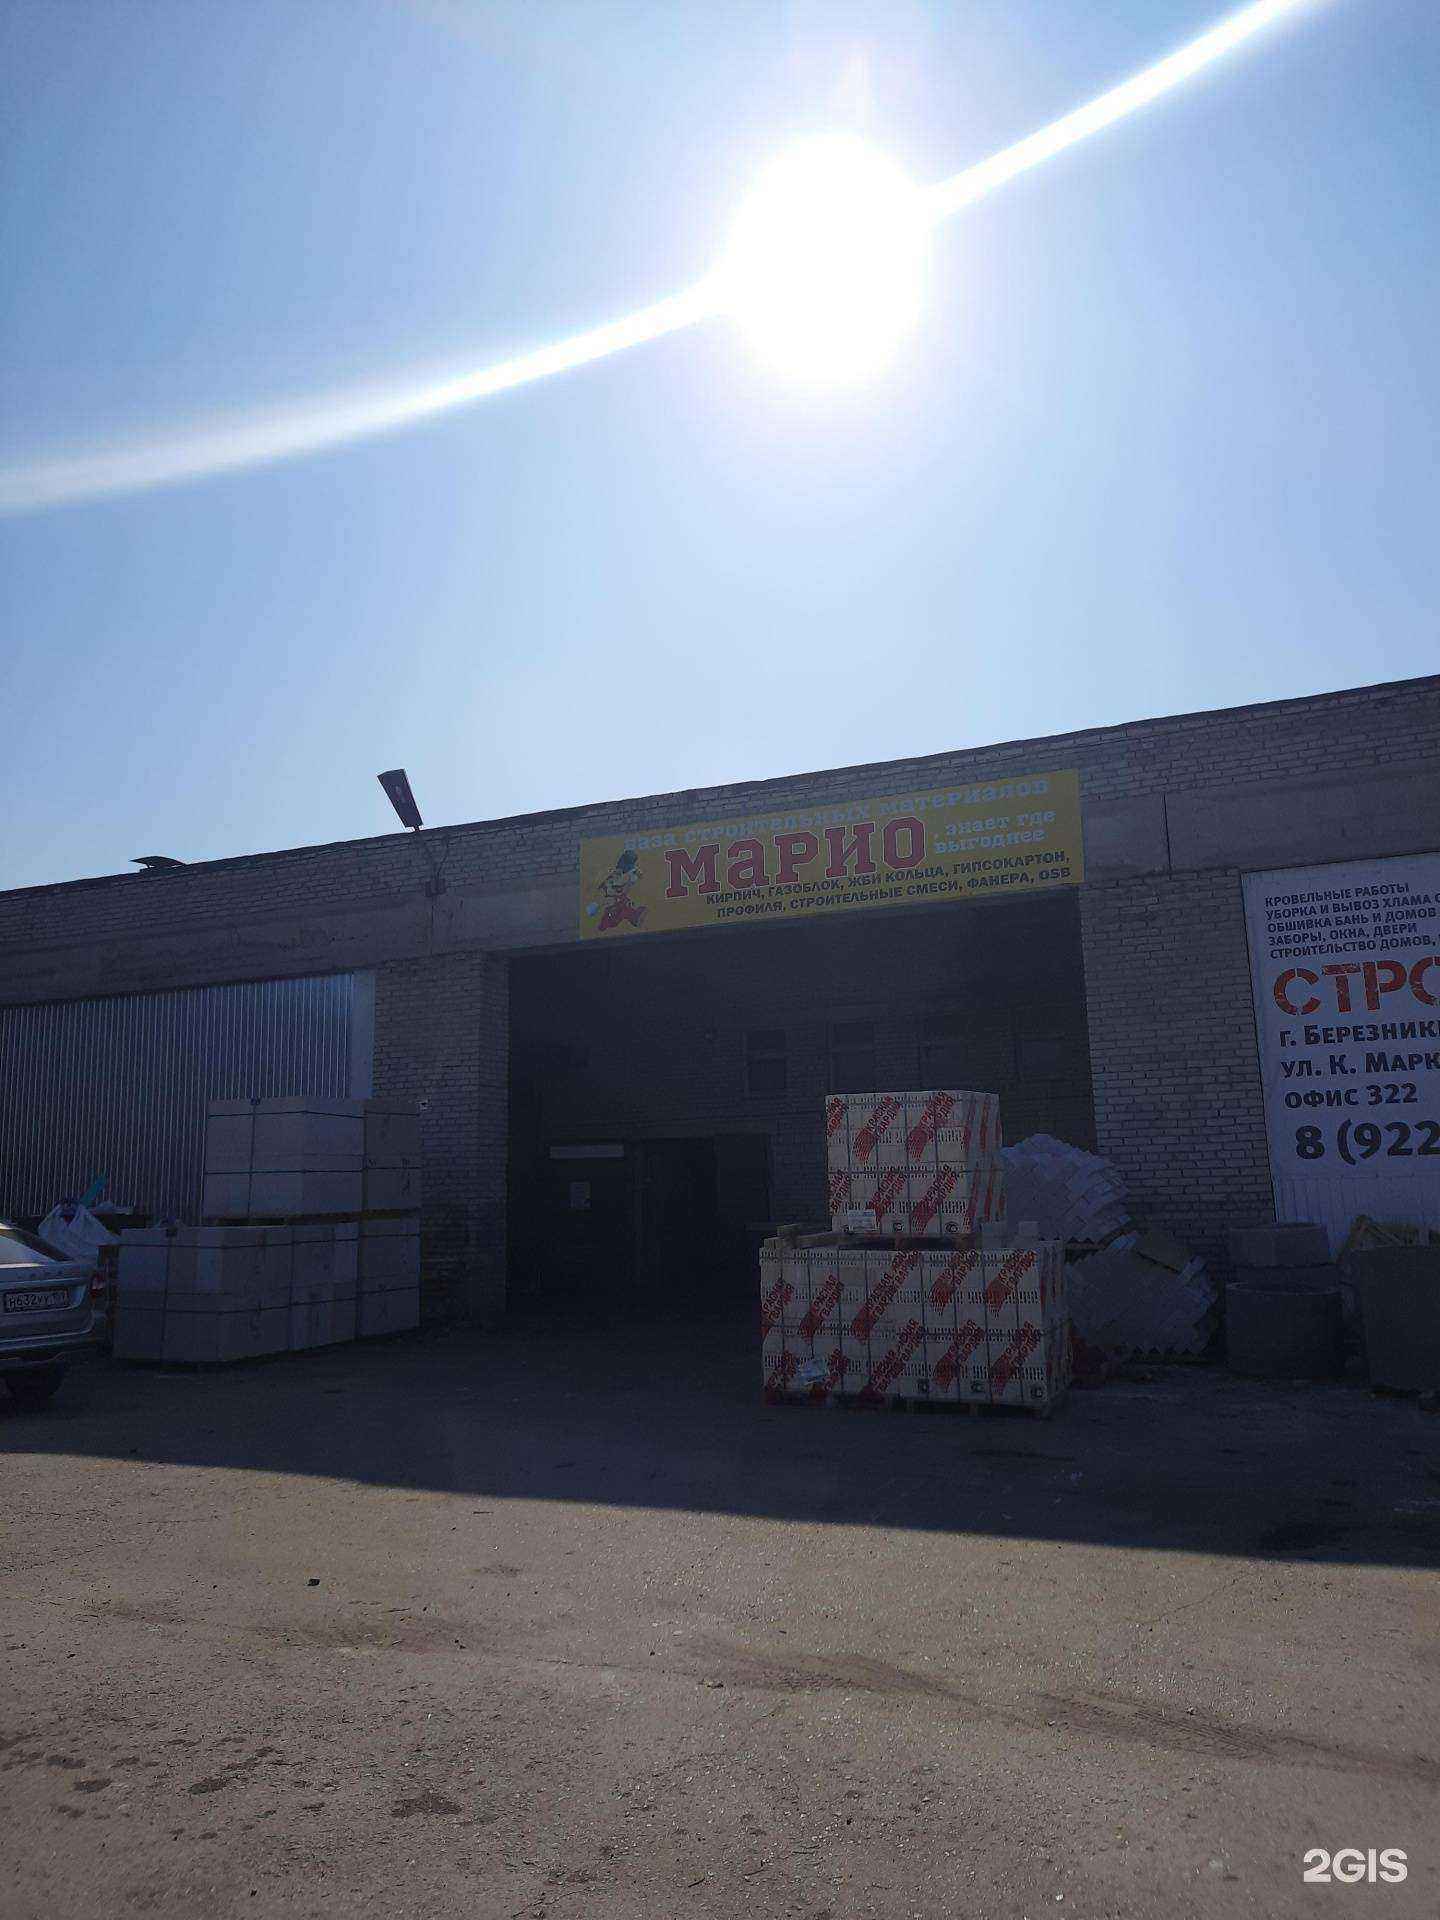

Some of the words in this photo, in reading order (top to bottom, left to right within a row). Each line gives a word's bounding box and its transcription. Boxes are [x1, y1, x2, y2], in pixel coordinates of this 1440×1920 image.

[879, 780, 1050, 815] материалов
[706, 887, 765, 905] КИРПИЧ,
[767, 880, 845, 898] ГАЗОБЛОК,
[885, 866, 949, 882] КОЛЬЦА,
[953, 851, 1070, 875] ГИПСОКАРТОН,
[717, 901, 786, 918] ПРОФИЛЯ,
[790, 884, 903, 910] СТРОИТЕЛЬНЫЕ
[906, 879, 963, 897] СМЕСИ,
[966, 872, 1034, 889] ФАНЕРА,
[1265, 888, 1352, 907] КРОВЕЛЬНЫЕ
[1355, 882, 1409, 897] РАБОТЫ
[1266, 905, 1317, 920] УБОРКА
[1320, 904, 1329, 914] И
[1332, 899, 1380, 913] ВЫВОЗ
[1382, 893, 1432, 908] ХЛАМА
[1267, 917, 1332, 933] ОБШИВКА
[1335, 913, 1370, 926] БАНЬ
[1373, 912, 1381, 923] И
[1385, 907, 1437, 923] ДОМОВ
[1268, 931, 1326, 946] ЗАБОРЫ,
[1329, 927, 1370, 940] ОКНА,
[1373, 922, 1418, 938] ДВЕРИ
[1270, 940, 1377, 959] СТРОИТЕЛЬСТВО
[1379, 934, 1436, 951] ДОМОВ,
[1304, 1020, 1440, 1045] БЕРЕЗНИК
[1329, 1054, 1357, 1075] К.
[1366, 1082, 1418, 1106] 322
